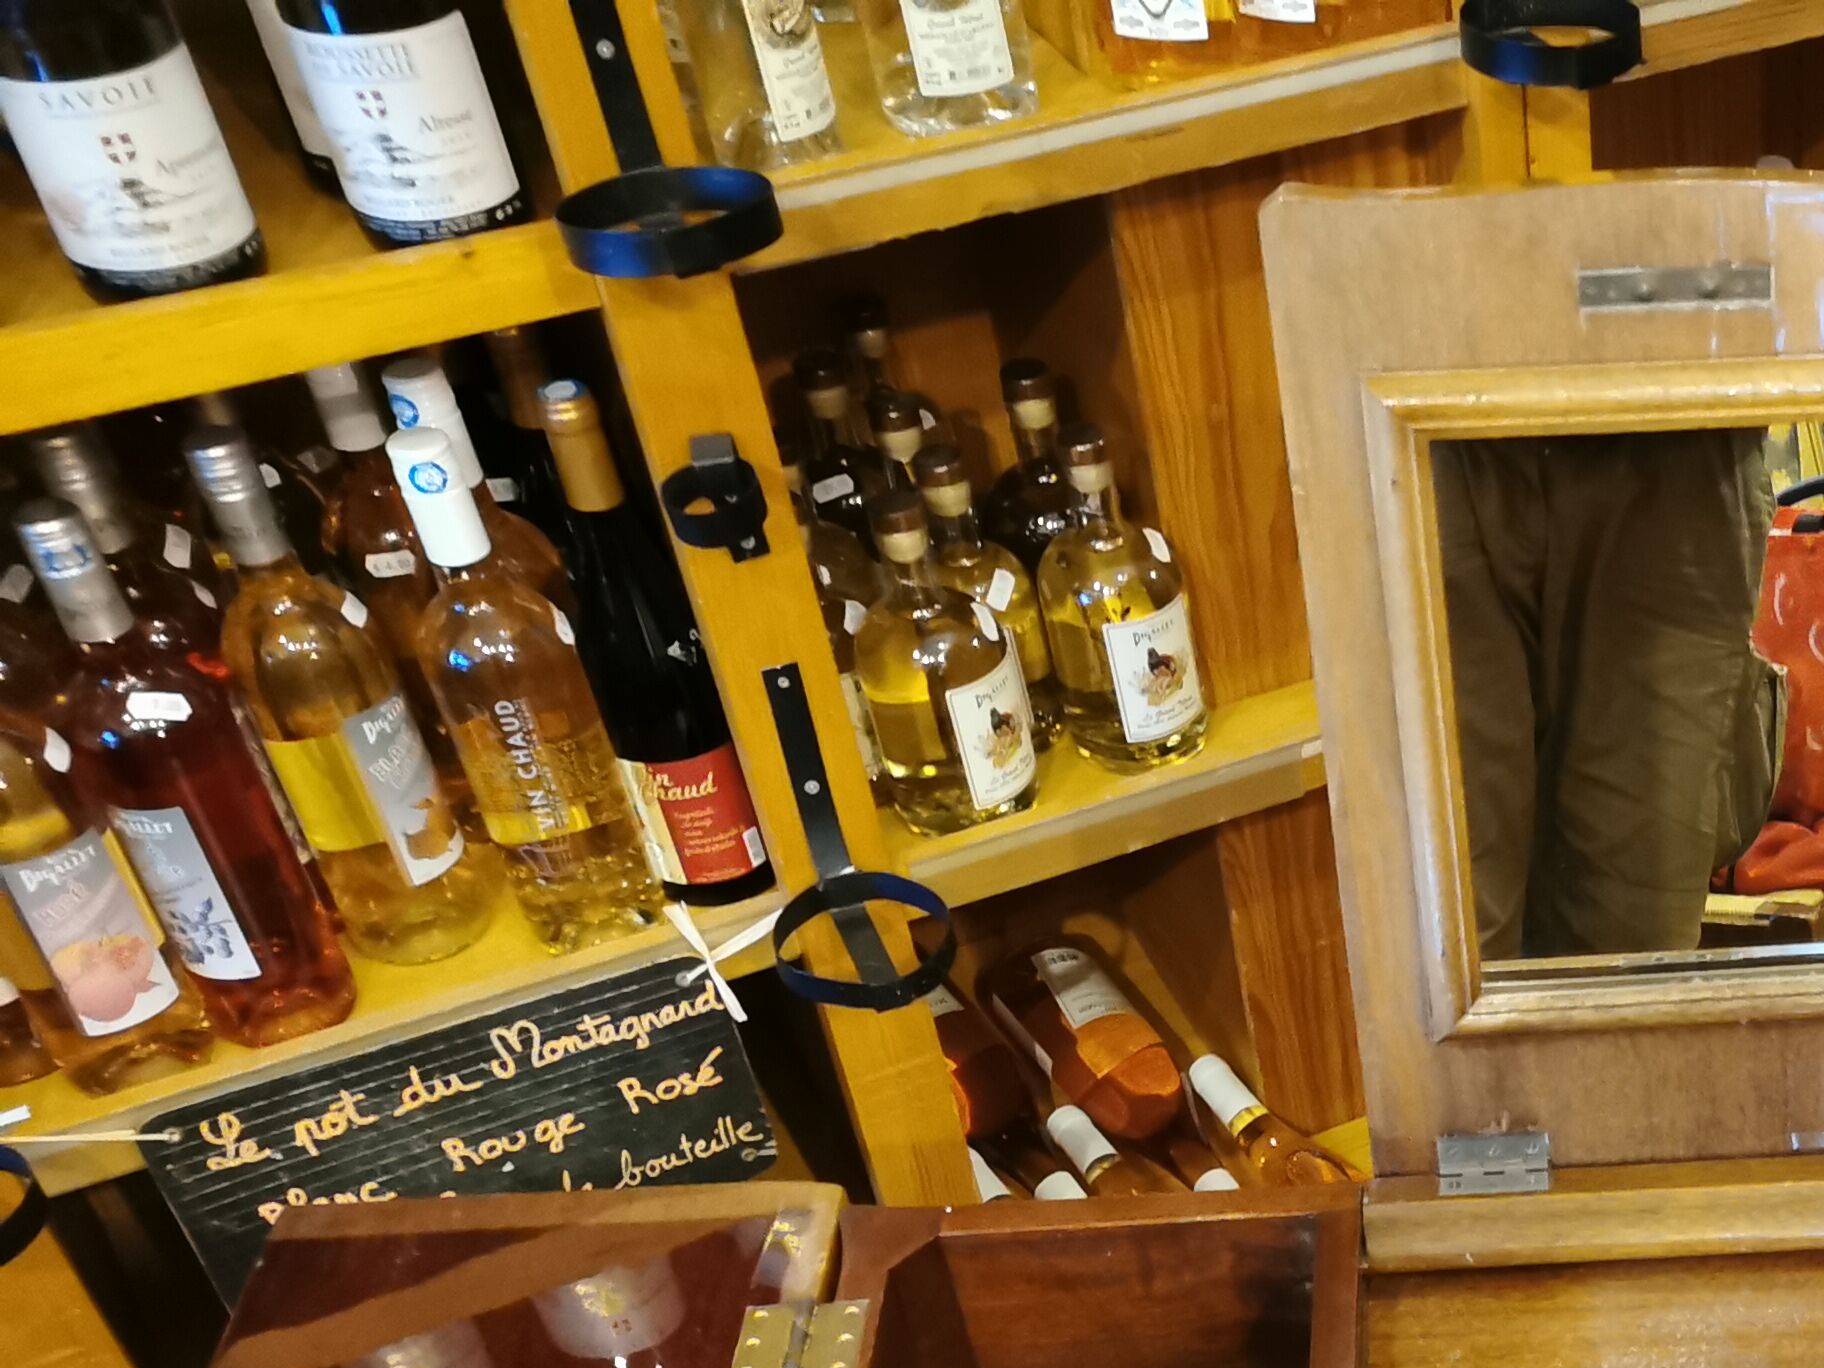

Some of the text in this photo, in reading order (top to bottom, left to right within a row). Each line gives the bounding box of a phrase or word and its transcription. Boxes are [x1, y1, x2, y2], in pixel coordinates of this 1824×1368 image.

[494, 700, 539, 780] CHAUD
[199, 1111, 270, 1172] Le
[393, 1065, 483, 1118] du
[489, 978, 726, 1080] Montagnard
[615, 1045, 724, 1115] Rosé
[615, 1115, 764, 1191] bouteille
